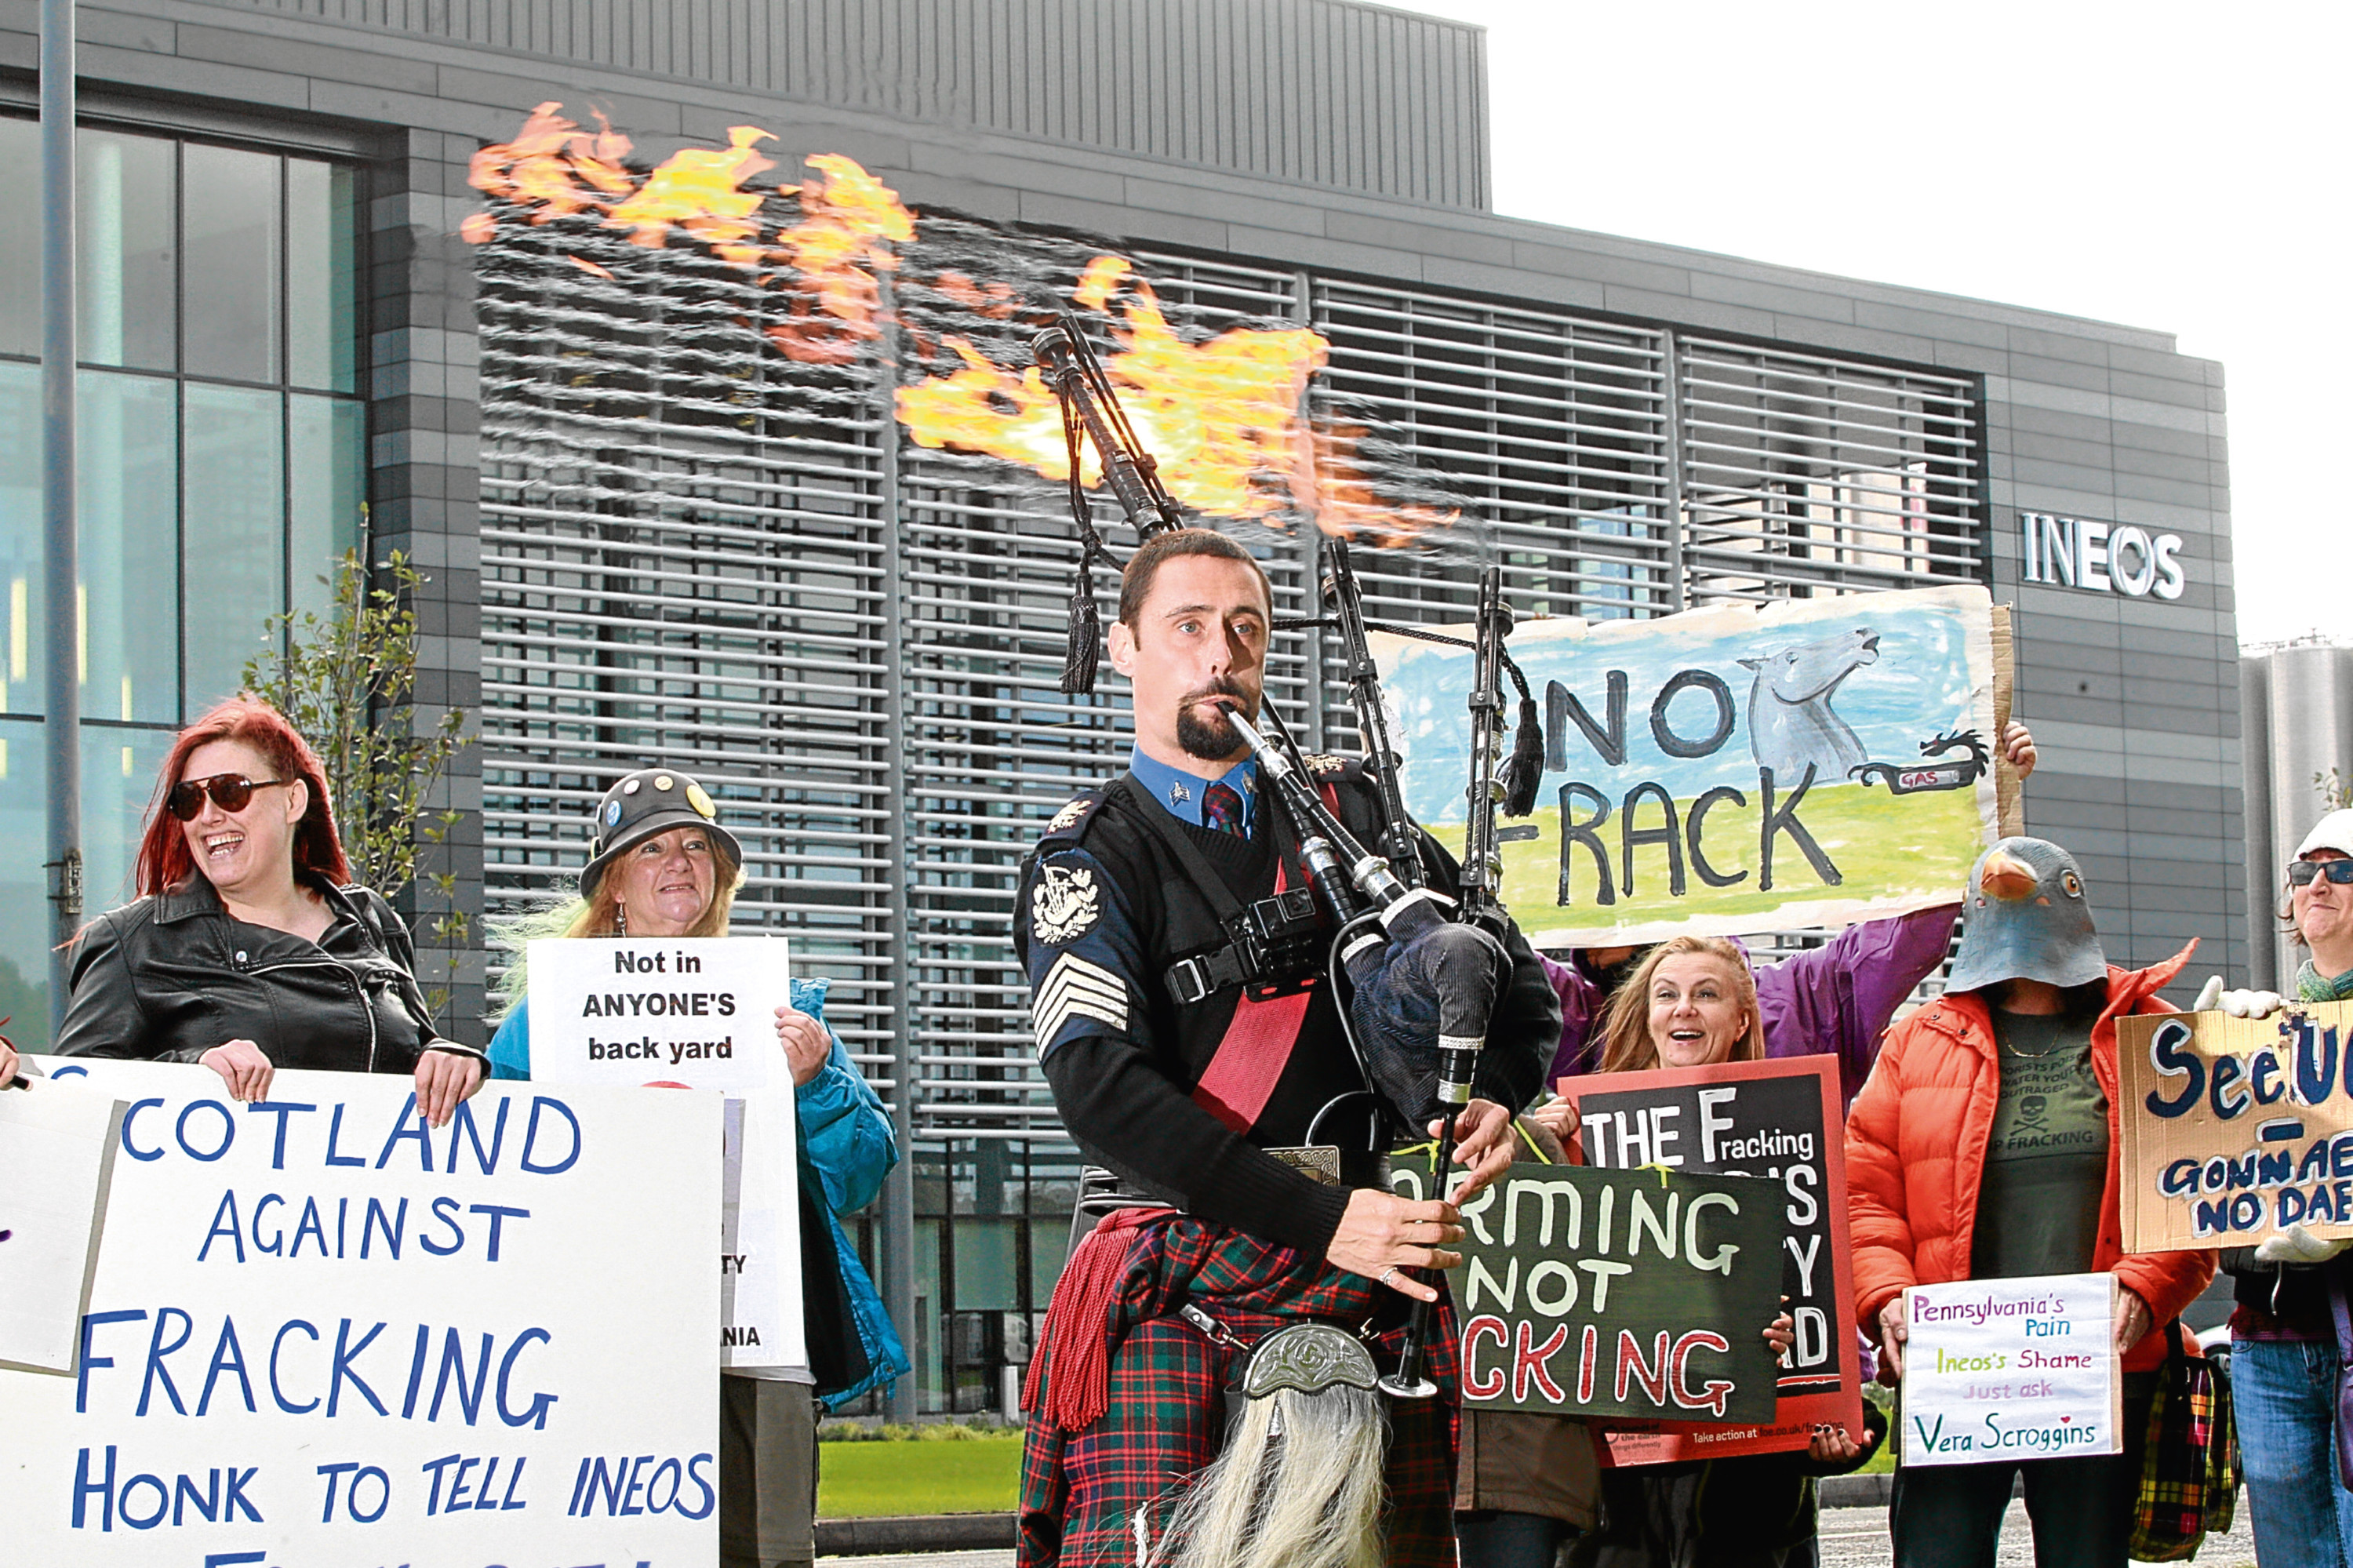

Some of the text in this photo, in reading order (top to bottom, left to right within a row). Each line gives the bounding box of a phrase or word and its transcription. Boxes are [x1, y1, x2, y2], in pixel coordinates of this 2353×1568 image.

[2021, 512, 2184, 600] INEOS
[1545, 668, 1736, 773] NO
[1902, 772, 1938, 788] GAS
[615, 951, 701, 973] Not in
[582, 993, 736, 1017] ANYONE'S
[589, 1036, 733, 1064] back yard
[2001, 1062, 2047, 1075] ORISTS
[51, 1065, 582, 1175] COTLAND
[1581, 1087, 1813, 1170] THE Fracking
[2007, 1130, 2093, 1151] FRACKING
[198, 1188, 532, 1264] AGAINST
[2191, 1192, 2268, 1238] NO
[1465, 1255, 1632, 1317] NOT
[1914, 1293, 2064, 1325] Pennsylvania's
[720, 1326, 761, 1347] NIA
[2026, 1316, 2071, 1337] Pain
[75, 1306, 559, 1431] FRACKING
[1937, 1348, 2092, 1373] Ineos's Shame
[2020, 1380, 2053, 1398] ask
[1693, 1432, 1715, 1444] Take
[1715, 1429, 1745, 1442] action
[1747, 1428, 1758, 1439] at
[1915, 1413, 2096, 1453] Vera Scroggins
[71, 1445, 715, 1533] HONK TO TELL INEOS
